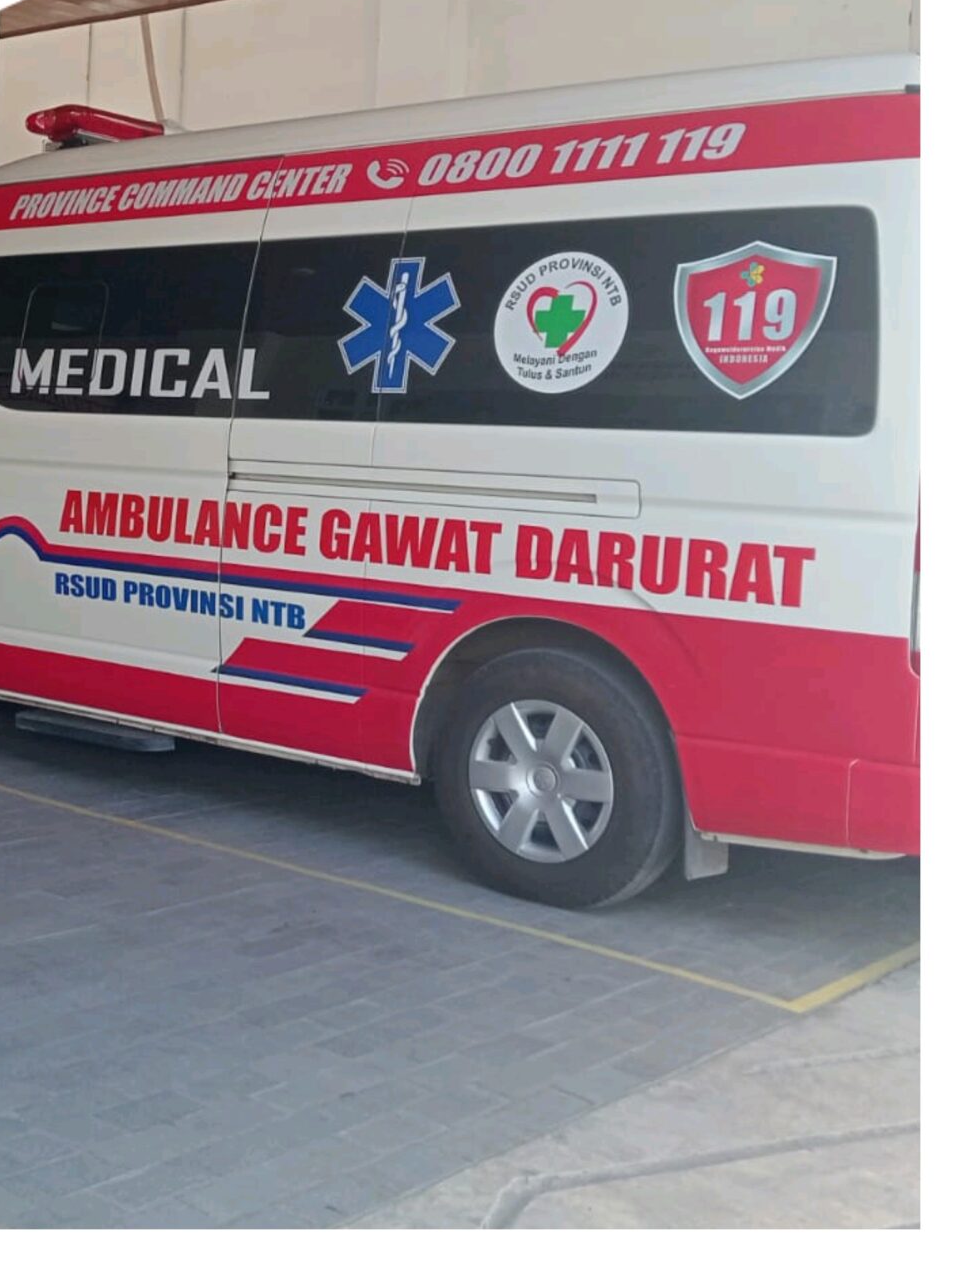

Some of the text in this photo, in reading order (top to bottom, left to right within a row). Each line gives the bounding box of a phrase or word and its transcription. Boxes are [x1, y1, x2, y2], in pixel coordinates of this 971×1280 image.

[10, 123, 746, 220] PROVINCE COMMAND CENTER 0800 1111 119
[505, 258, 622, 310] RSUD PROVINSI NTB
[703, 288, 797, 341] 119
[10, 348, 270, 399] MEDICAL
[513, 349, 597, 367] Melayani Dengan
[516, 363, 592, 380] Tulus & Santun
[719, 354, 768, 363] INDONESIA
[59, 490, 816, 608] AMBULANCE GAWAT DARURAT
[55, 573, 305, 630] RSUD PROVINSI NTB
